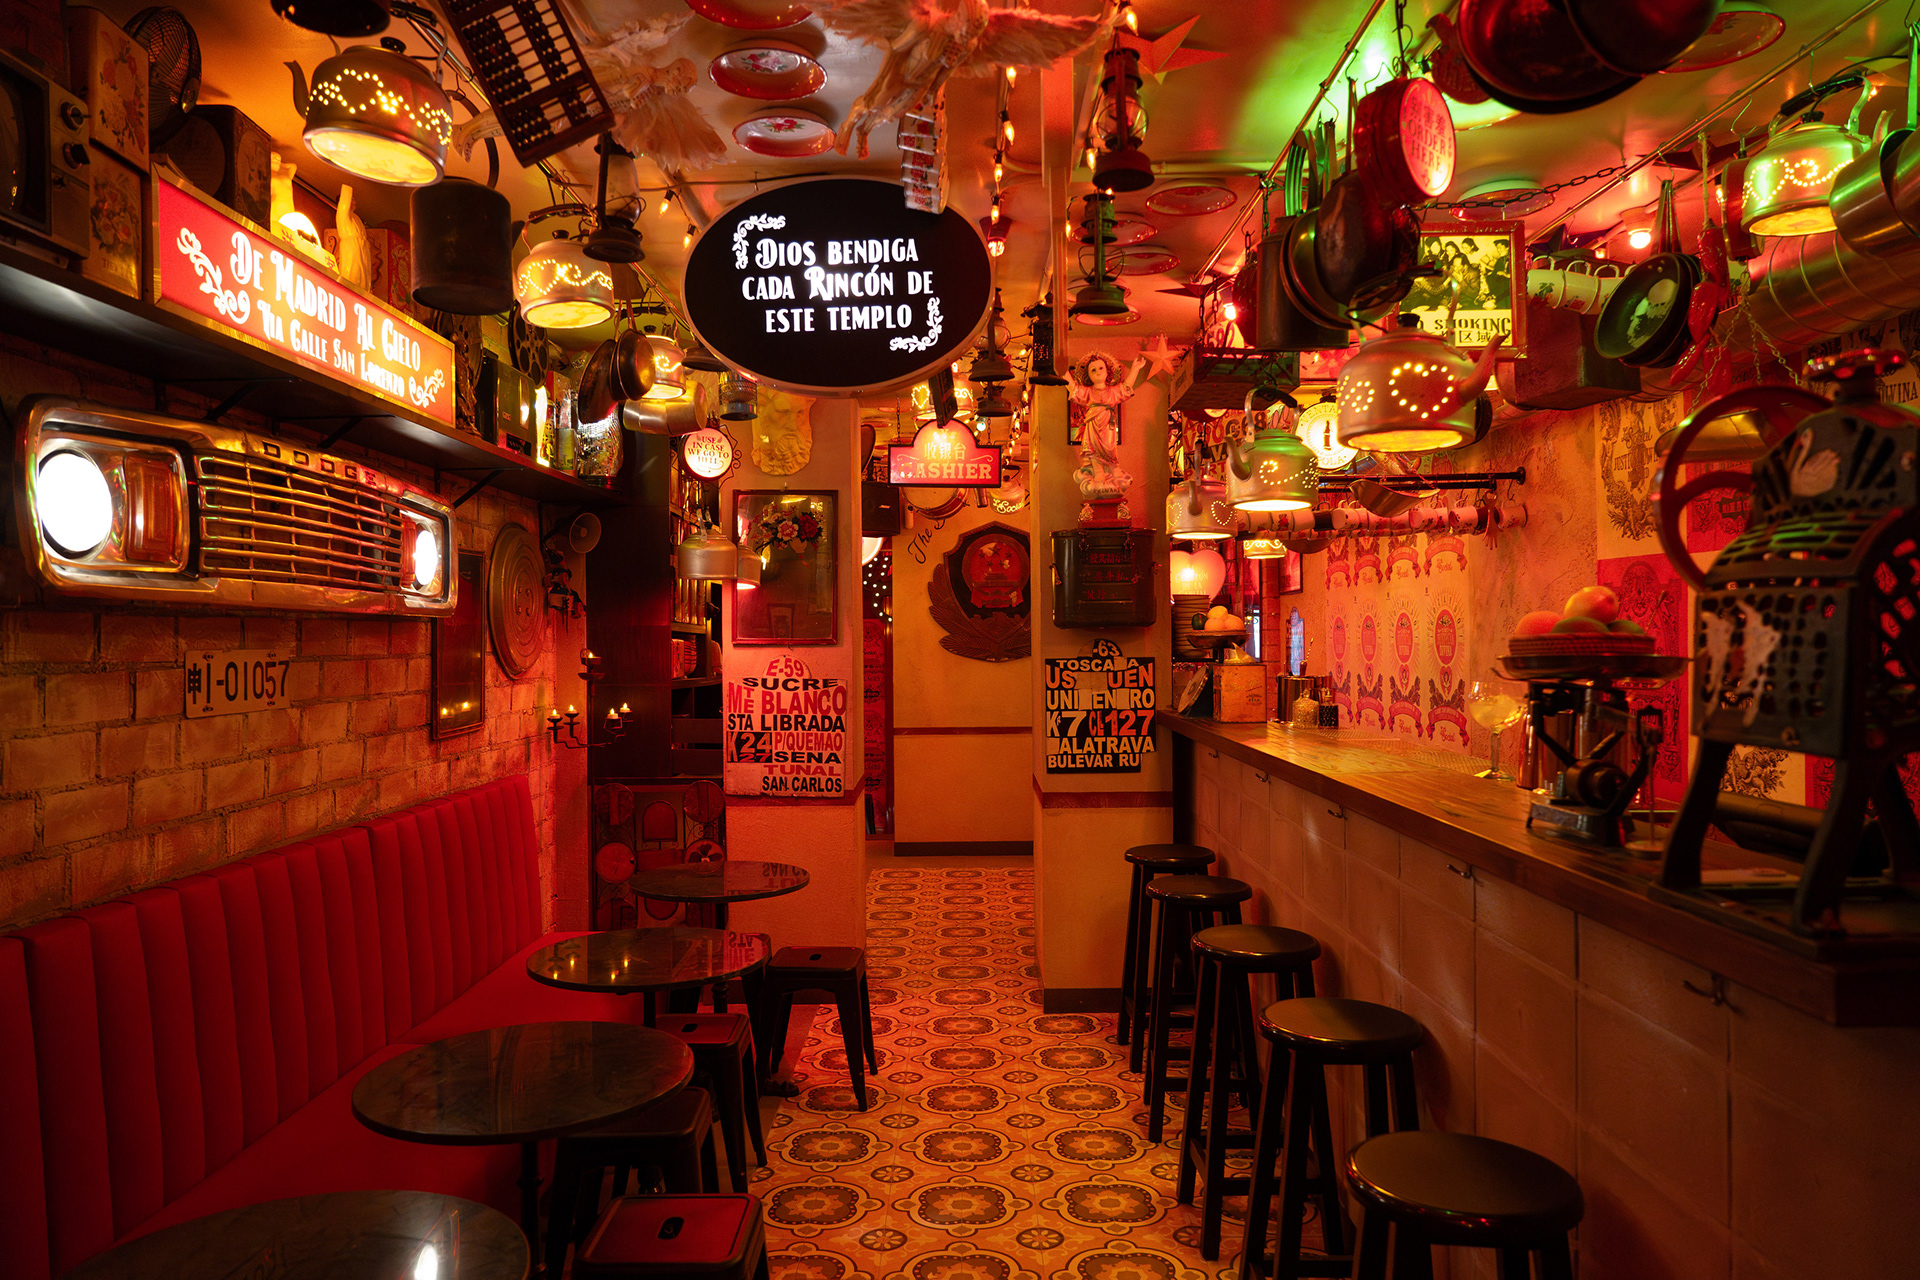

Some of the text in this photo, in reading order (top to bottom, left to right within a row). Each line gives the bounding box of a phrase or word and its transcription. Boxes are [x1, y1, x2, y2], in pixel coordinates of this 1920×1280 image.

[1408, 118, 1447, 160] ORDER
[1410, 140, 1441, 173] HERE
[755, 238, 919, 269] DIOS BENDIGA
[742, 264, 934, 301] CADA RINCÓN DE
[229, 231, 421, 372] DE MADRID AL CIELO
[765, 304, 913, 333] ESTE TEMPLO
[1434, 317, 1511, 335] SOKING
[289, 318, 328, 363] CALLE
[332, 338, 355, 376] SAN
[360, 352, 405, 397] LORENZO
[702, 436, 717, 444] USE
[704, 444, 725, 452] CASE
[687, 448, 701, 456] WE
[924, 442, 966, 461] 收银台
[262, 440, 377, 487] DODGE
[907, 528, 933, 564] The
[766, 658, 804, 678] E-59
[1056, 659, 1139, 671] TOSCAA
[742, 677, 839, 691] SUCRE
[1045, 663, 1154, 689] USUEN
[761, 685, 847, 716] BLANCO
[1046, 688, 1155, 710] UNIENRO
[727, 713, 846, 732] STA LIBRADA
[1104, 710, 1155, 736] 127
[774, 732, 843, 751] P/QUEMAO
[1060, 736, 1155, 754] ALATRAVA
[774, 752, 841, 763] SENA
[1048, 754, 1113, 768] BULEVAR
[763, 764, 841, 777] TUNAL
[762, 776, 842, 793] SAN CARLOS
